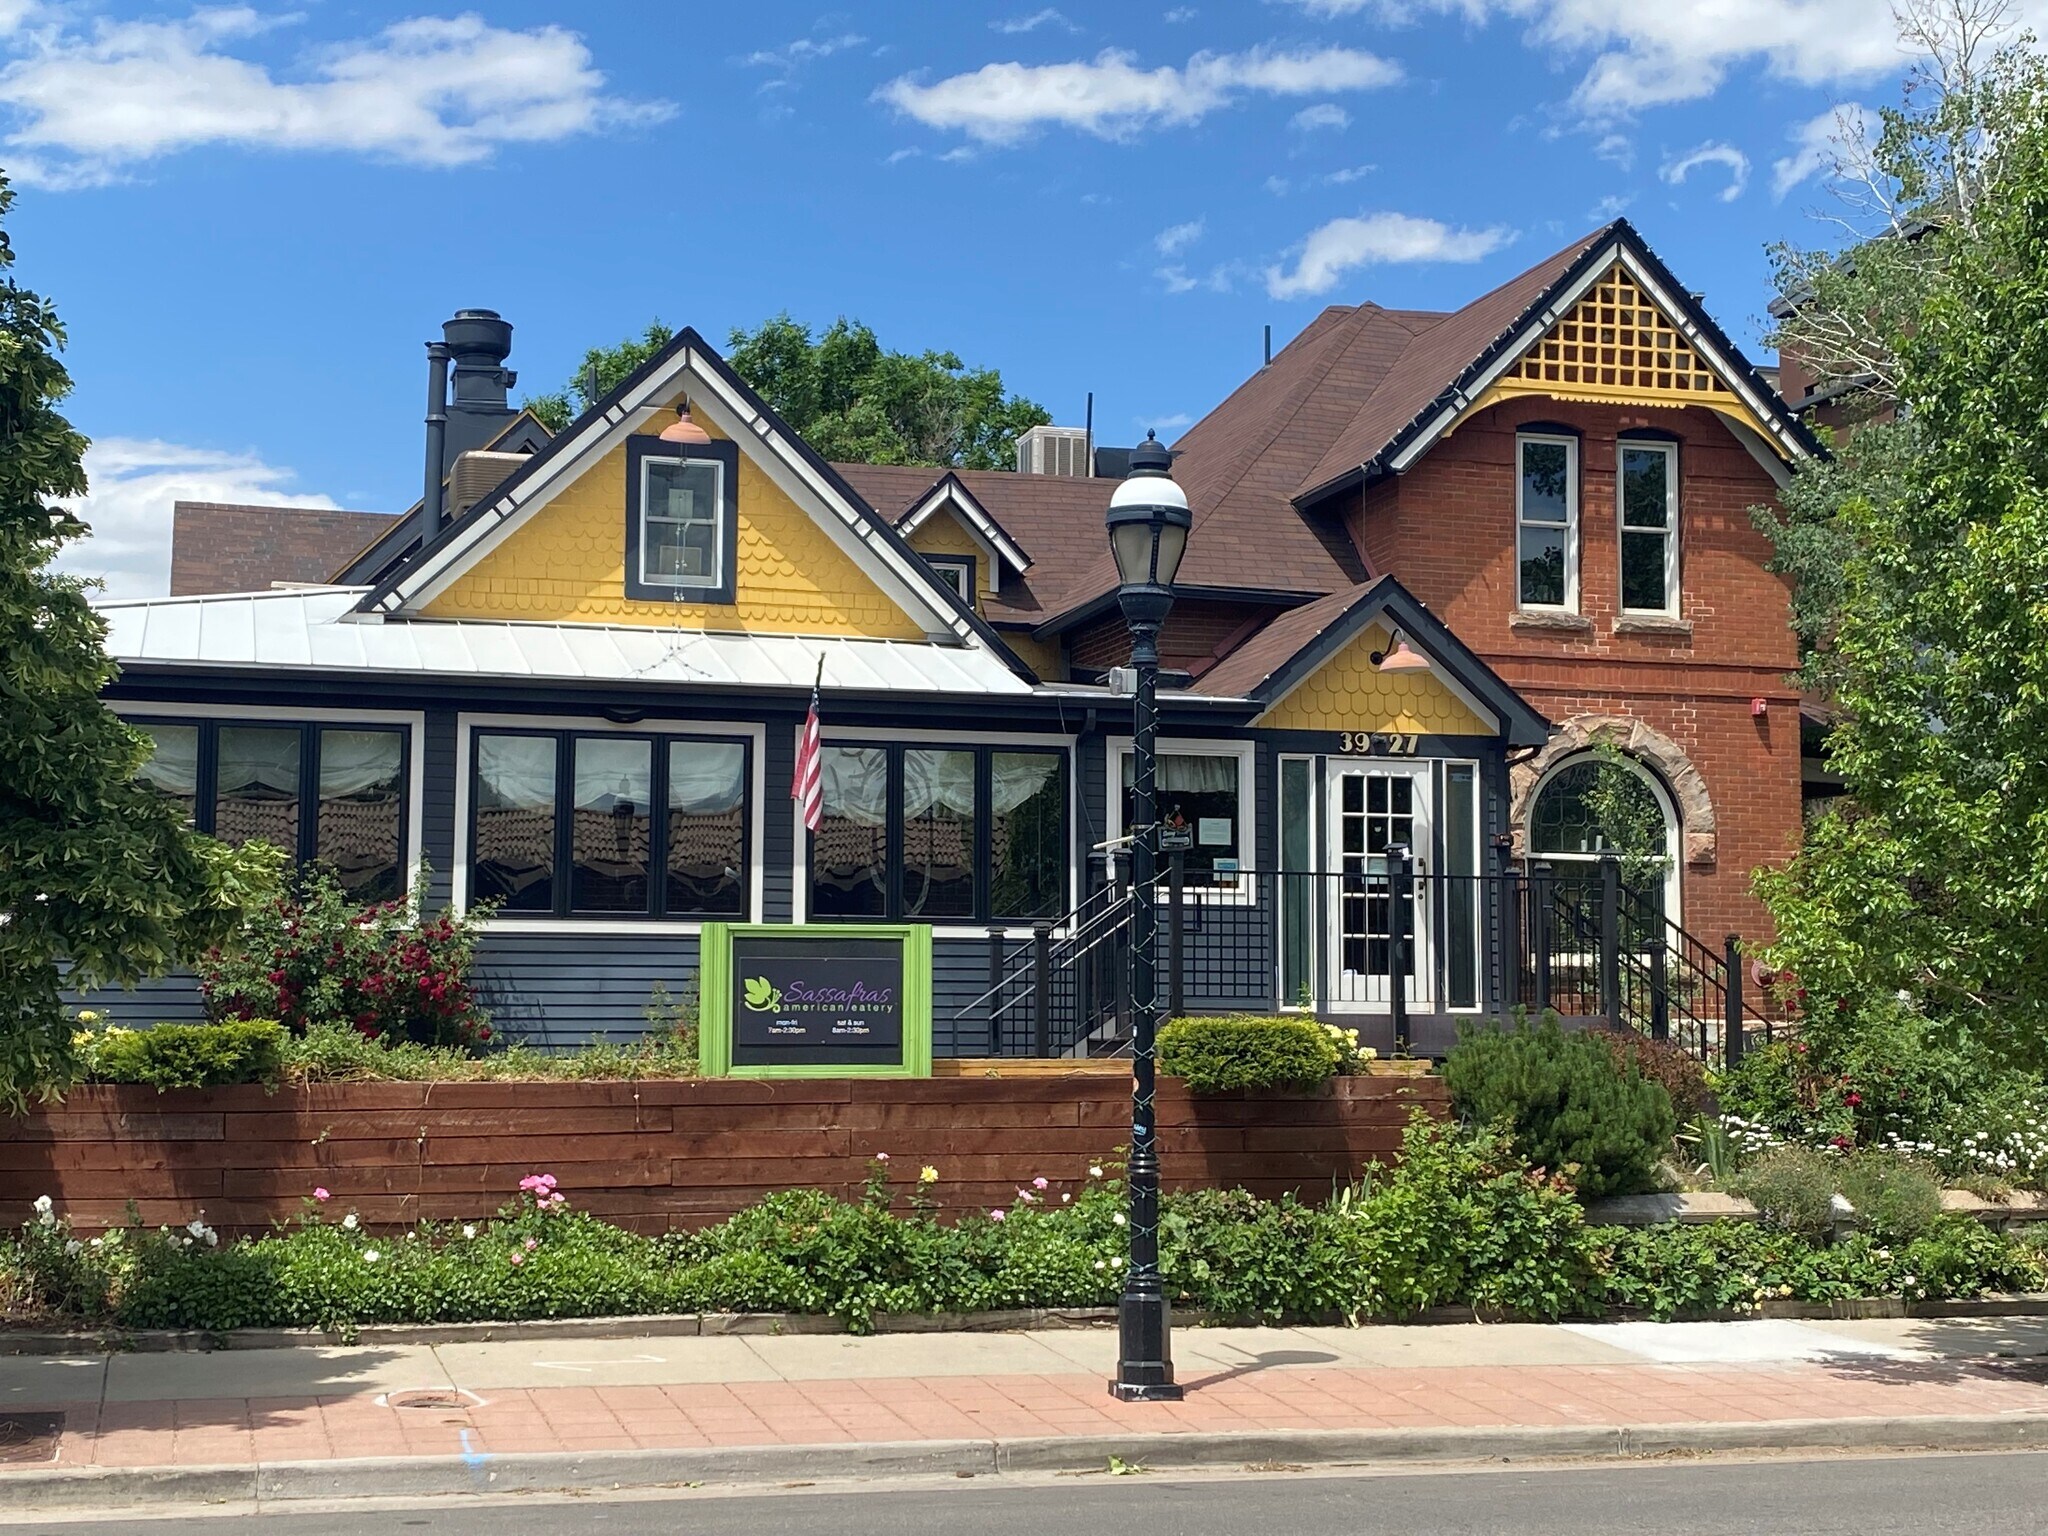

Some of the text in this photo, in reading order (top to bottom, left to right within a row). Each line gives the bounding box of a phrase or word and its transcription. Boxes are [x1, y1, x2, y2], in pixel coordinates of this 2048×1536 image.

[1339, 732, 1419, 754] 39 27
[784, 981, 892, 1012] Sassafras
